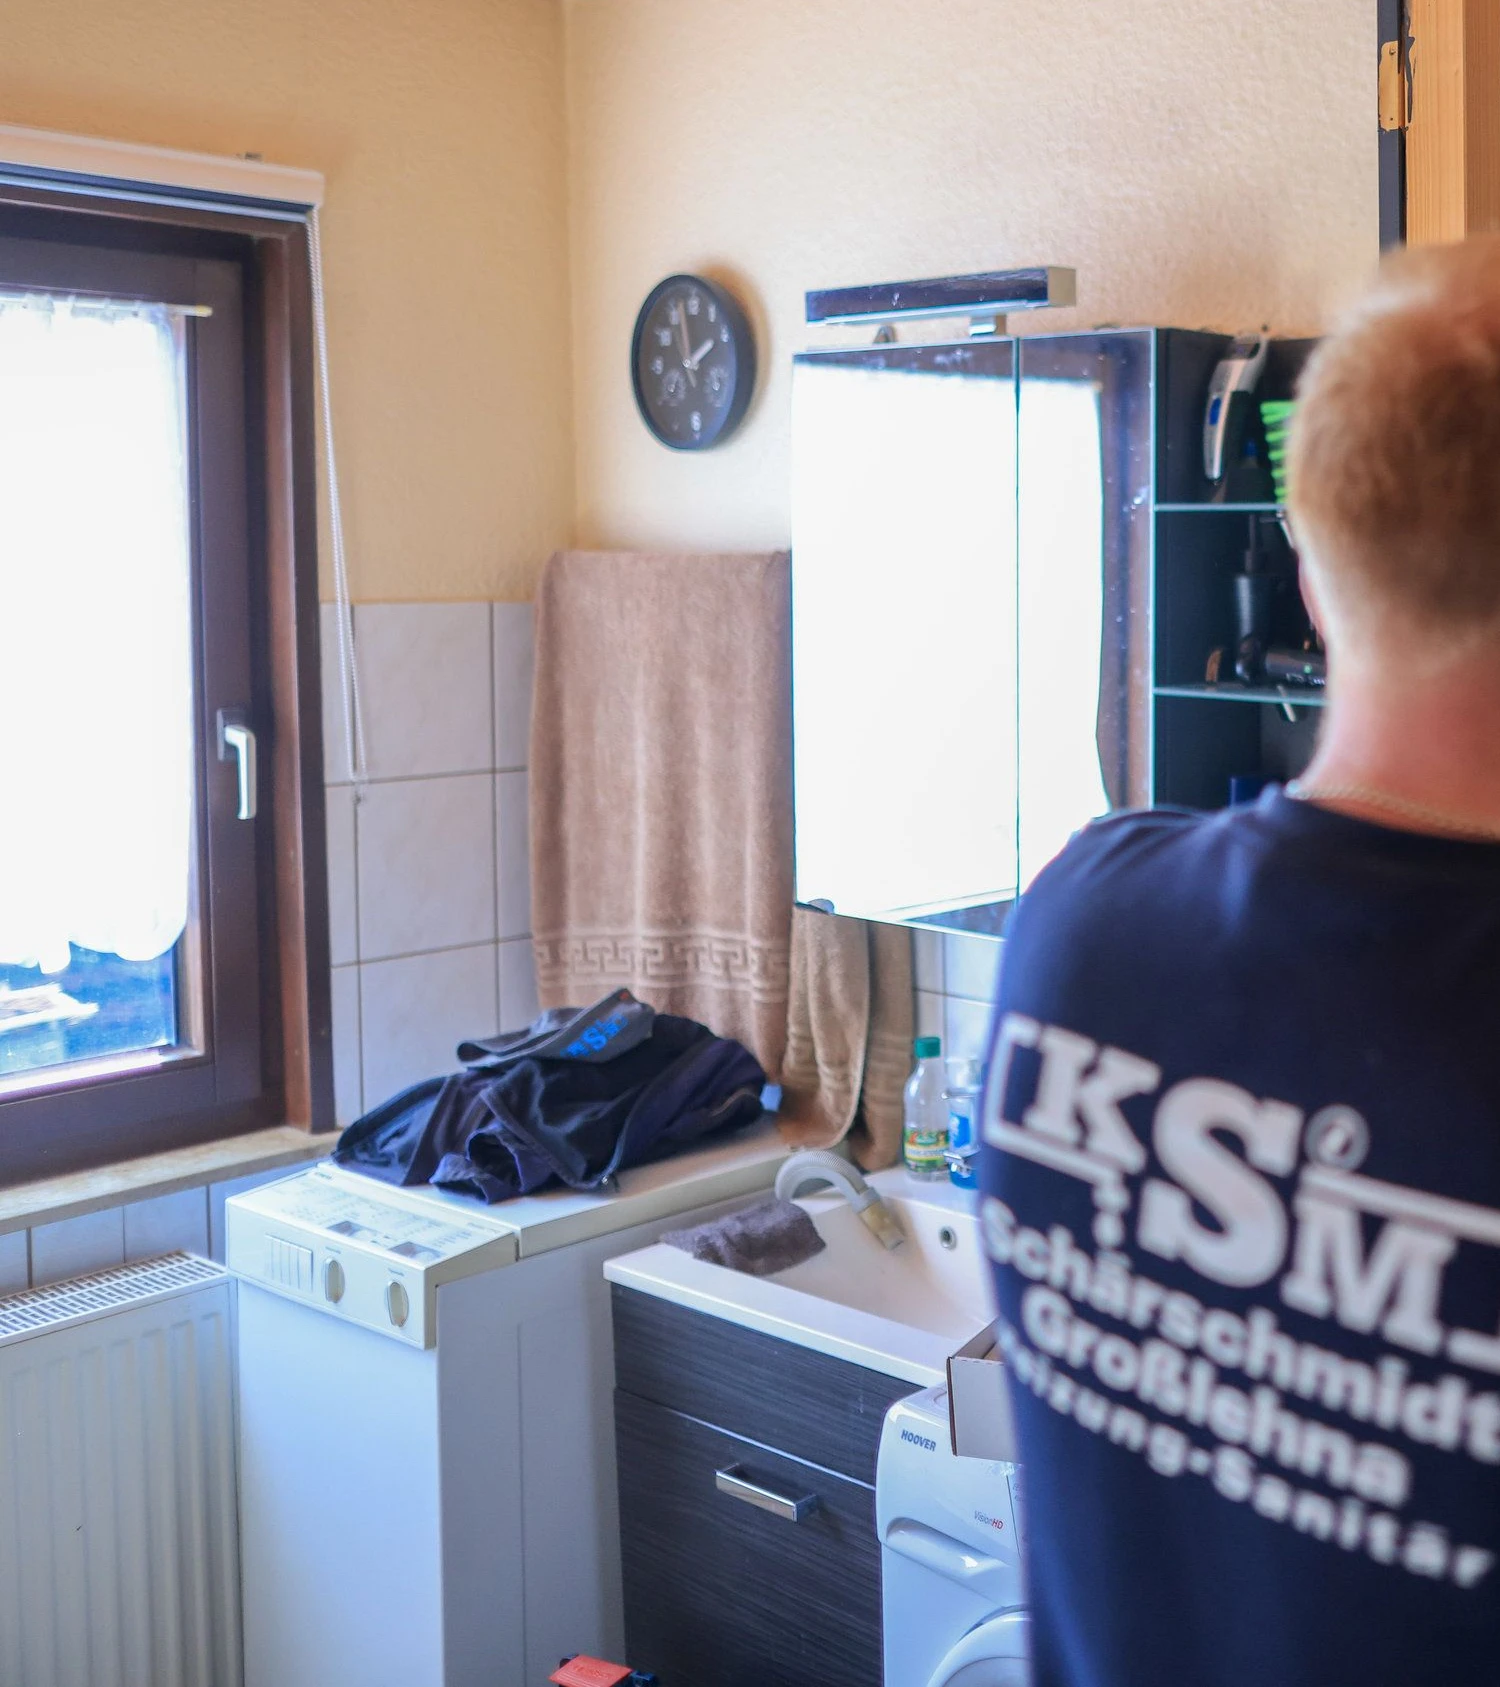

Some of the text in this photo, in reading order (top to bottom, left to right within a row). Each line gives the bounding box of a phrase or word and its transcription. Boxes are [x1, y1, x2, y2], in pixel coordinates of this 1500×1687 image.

[1022, 1025, 1458, 1358] KSM
[901, 1429, 937, 1451] HOOVER
[1000, 1318, 1496, 1590] eizung-Sanitär
[1020, 1284, 1412, 1504] Großlehna
[974, 1510, 1004, 1530] VisionHD
